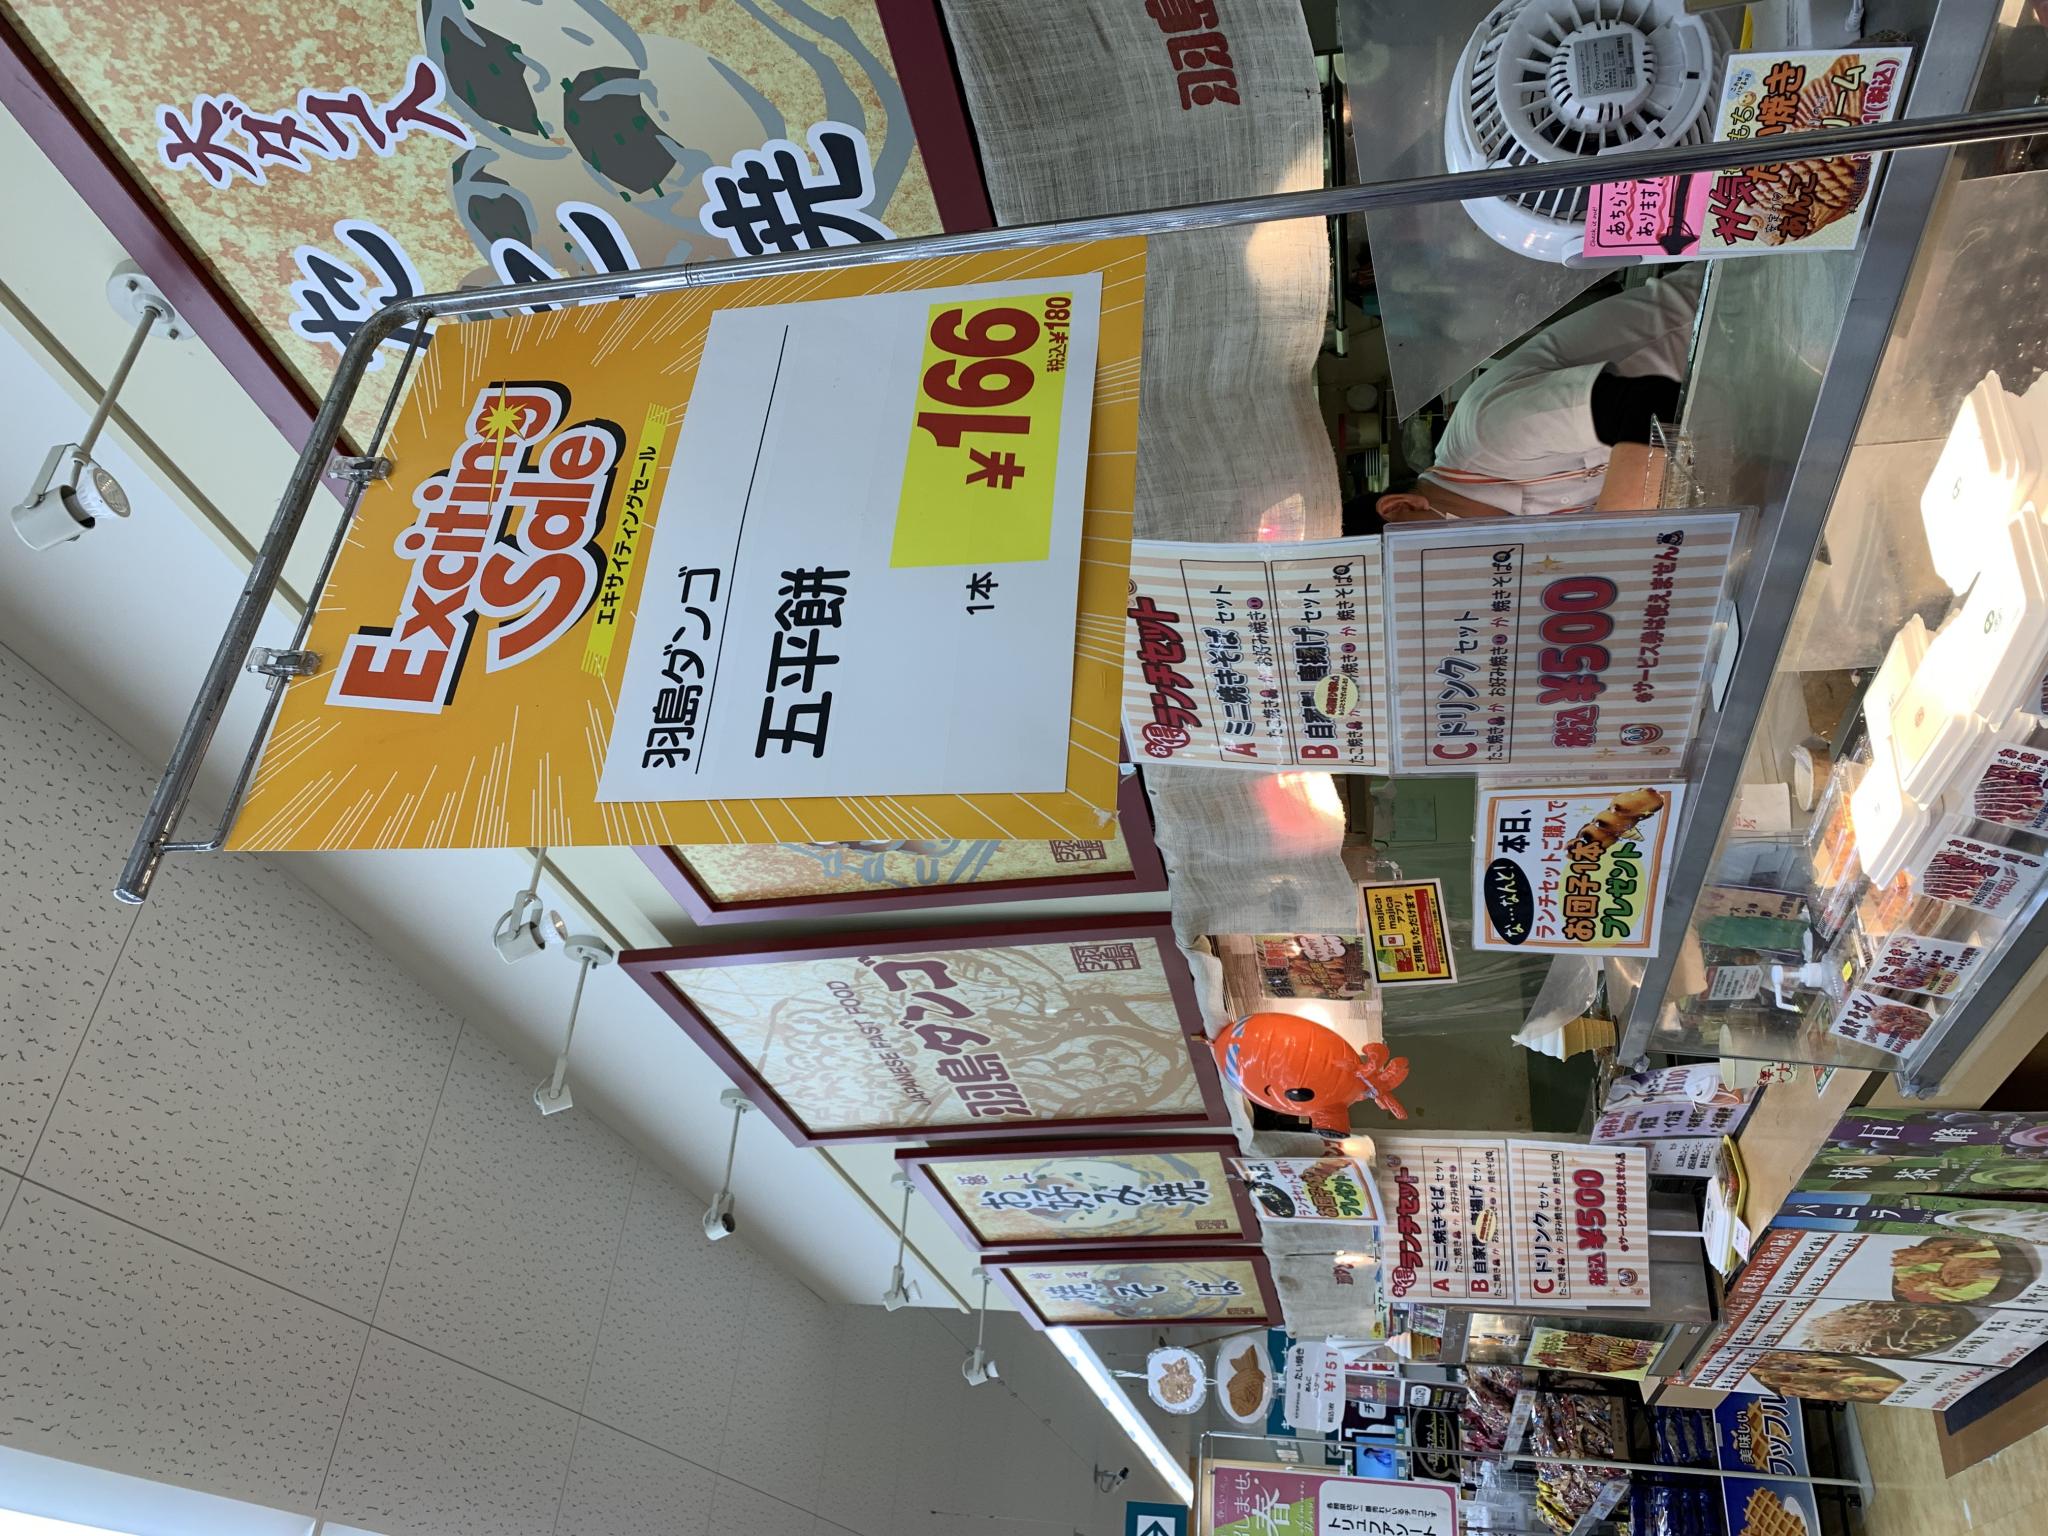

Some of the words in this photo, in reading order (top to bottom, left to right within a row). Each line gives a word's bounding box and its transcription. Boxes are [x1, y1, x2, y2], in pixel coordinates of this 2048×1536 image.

[160, 60, 470, 184] 大ダコ入
[1605, 182, 1628, 237] あちらに
[1777, 172, 1818, 238] あんこ
[1589, 228, 1597, 248] Check
[1045, 296, 1073, 372] 税込¥180
[916, 306, 1042, 490] ¥166
[328, 386, 558, 709] Exciting
[480, 424, 615, 668] Sale
[596, 445, 658, 625] エキサイティングセール
[966, 570, 999, 616] 1本
[1209, 584, 1235, 624] セット
[1296, 583, 1322, 623] セット
[1333, 575, 1357, 621] 焼きそば
[1493, 561, 1513, 612] 焼きそば
[1248, 610, 1273, 667] お好み焼き
[1454, 610, 1480, 654] セット
[1536, 575, 1618, 705] ¥500
[641, 565, 721, 769] 羽島ダンゴ
[754, 565, 851, 758] 五平餅
[1127, 596, 1202, 727] ランチセット
[1201, 626, 1255, 736] ミニ焼きそば
[1488, 645, 1508, 697] お好み焼き
[1260, 698, 1283, 738] たこ焼き
[1433, 656, 1480, 737] ドリンク
[1141, 722, 1191, 758] お得
[1344, 730, 1364, 763] たこ焼き
[1486, 725, 1507, 761] たこ焼き
[1551, 704, 1600, 748] 税込
[1225, 742, 1257, 758] A
[1300, 745, 1339, 759] B
[1433, 742, 1478, 760] C
[1497, 808, 1532, 854] 本日、
[1536, 800, 1568, 938] ランチセットご購入で
[1561, 840, 1605, 941] お団子1本
[1599, 841, 1642, 938] プレゼント
[1385, 896, 1397, 929] majica
[1395, 900, 1406, 924] アプリ
[1404, 892, 1425, 972] ご利用いただけます
[1871, 947, 1913, 984] たこ焼き
[825, 980, 871, 1016] FOOD
[1838, 999, 1873, 1039] 焼きそば
[853, 1019, 891, 1049] FAST
[855, 954, 1033, 1118] 羽島ダンゴ
[878, 1051, 932, 1106] JAPANESE
[1857, 1123, 1979, 1143] 巨峰
[1432, 1157, 1445, 1182] セット
[1470, 1159, 1482, 1183] セット
[1826, 1166, 1941, 1180] 抹茶
[981, 1180, 1209, 1210] お好み焼
[1331, 1175, 1363, 1216] プレゼント
[1449, 1173, 1461, 1213] お好み焼き
[1537, 1182, 1549, 1210] セット
[1572, 1168, 1608, 1250] ¥500
[1795, 1203, 1901, 1218] バニラ
[1397, 1167, 1424, 1268] ランチセット
[1430, 1186, 1449, 1272] ミニ焼きそば
[1554, 1206, 1564, 1243] お好み焼き
[1452, 1240, 1464, 1273] たこ焼き
[1532, 1212, 1553, 1273] ドリンク
[1045, 1279, 1243, 1301] 焼そば
[1432, 1278, 1450, 1292] A
[1471, 1279, 1489, 1293] B
[1492, 1266, 1502, 1297] たこ焼き
[1533, 1279, 1555, 1294] C
[1556, 1265, 1567, 1296] たこ焼き
[1586, 1251, 1609, 1286] 税込
[1323, 1351, 1338, 1392] ¥151
[1736, 1410, 1754, 1464] 美味しい
[1759, 1394, 1798, 1475] ワッフル
[1233, 1472, 1250, 1536] しませ、
[1251, 1487, 1290, 1536] 春
